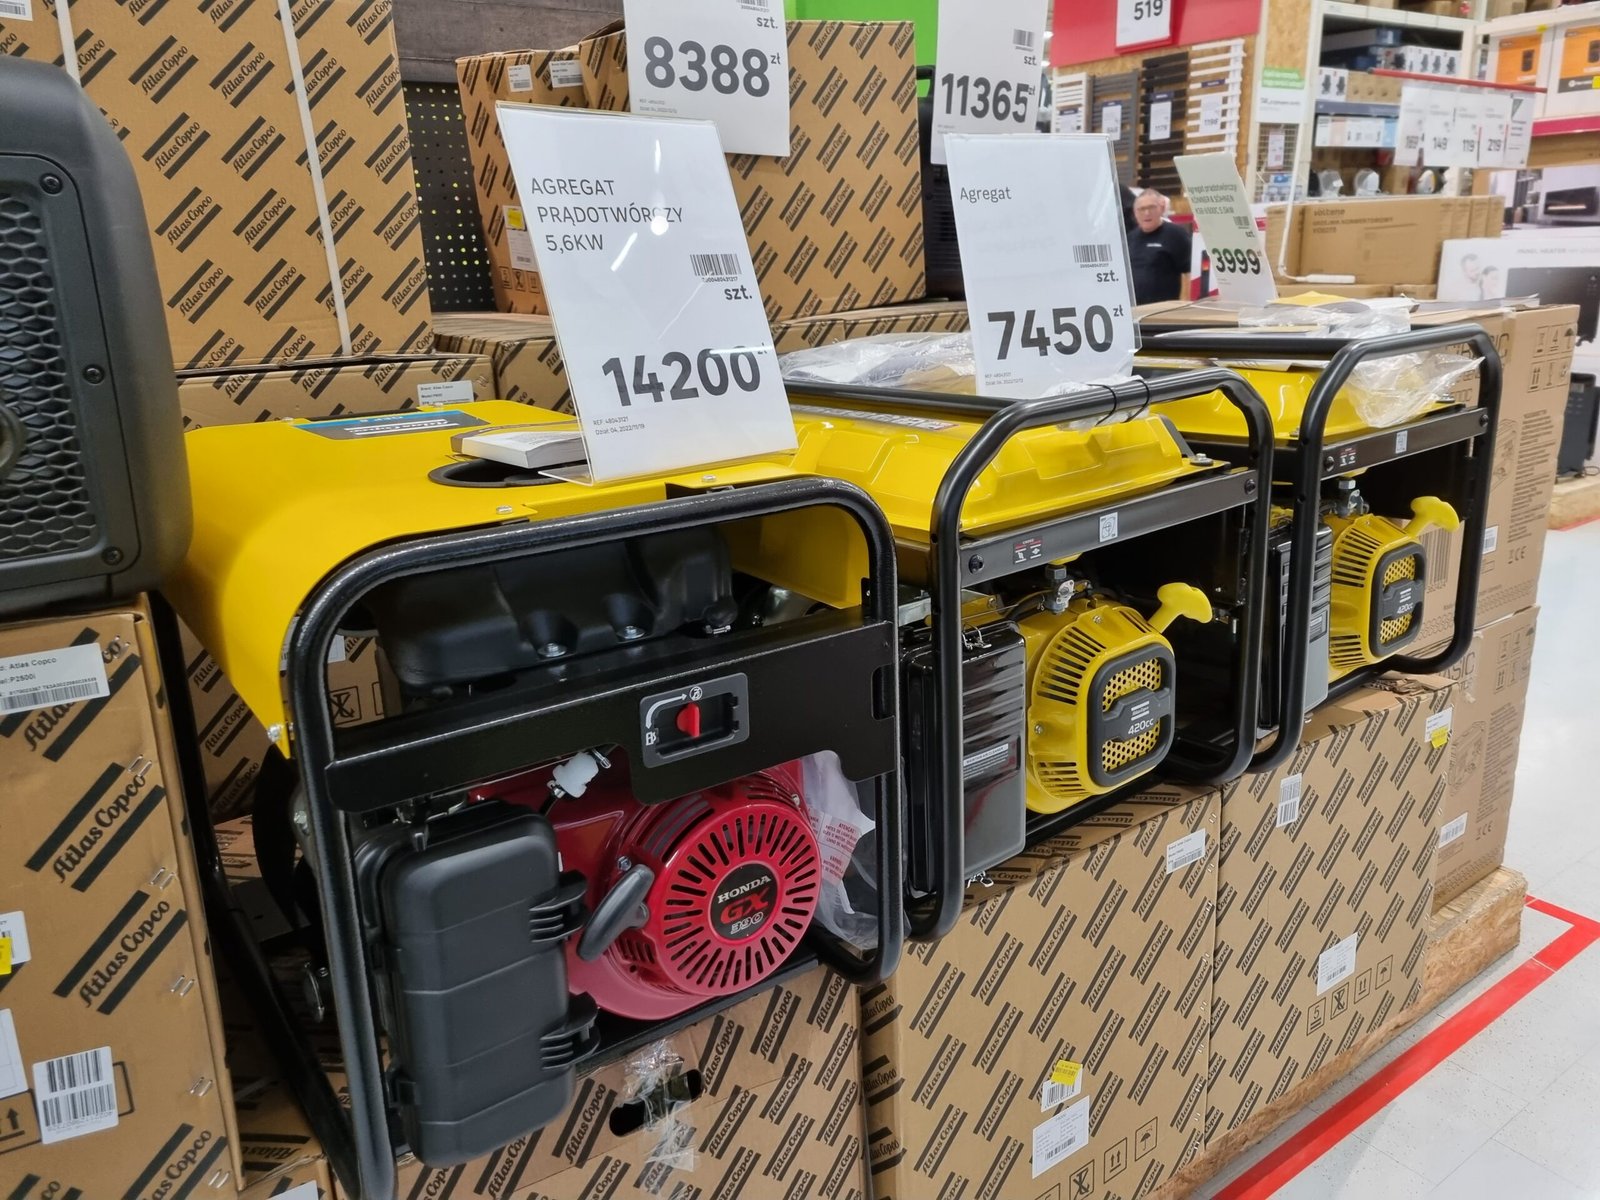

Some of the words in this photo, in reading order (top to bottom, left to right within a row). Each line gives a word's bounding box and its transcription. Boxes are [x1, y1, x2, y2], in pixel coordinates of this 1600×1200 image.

[757, 17, 778, 29] szt.
[1134, 0, 1163, 20] 519
[142, 67, 167, 96] Atlas
[162, 45, 188, 71] Copco
[222, 73, 246, 100] Atlas
[240, 51, 265, 76] Copco
[644, 36, 769, 97] 8388
[770, 52, 781, 65] zł
[941, 73, 1028, 123] 11365
[155, 144, 180, 172] Atlas
[175, 121, 200, 147] Copco
[233, 146, 257, 174] Atlas
[252, 125, 276, 150] Copco
[531, 178, 614, 196] AGREGAT
[960, 187, 1012, 204] Agregat
[168, 218, 192, 246] Atlas
[187, 195, 212, 221] Copco
[245, 218, 268, 245] Atlas
[263, 196, 286, 221] Copco
[546, 234, 603, 254] 5,6KW
[1096, 269, 1119, 283] szt.
[1212, 248, 1261, 275] 3999
[180, 290, 204, 317] Atlas
[199, 267, 223, 293] Copco
[255, 288, 278, 314] Atlas
[273, 266, 296, 291] Copco
[724, 285, 752, 300] szt.
[987, 305, 1114, 360] 7450
[1113, 305, 1124, 317] zł
[602, 345, 761, 407] 14200
[1397, 602, 1414, 614] 420cc
[10, 661, 30, 669] Atlas
[31, 657, 57, 667] Copco
[204, 727, 228, 757] Atlas
[1128, 718, 1154, 735] 420cc
[53, 826, 105, 884] Atlas
[94, 774, 145, 827] Copco
[1321, 850, 1334, 876] Atlas
[1333, 827, 1347, 851] Copco
[1356, 832, 1369, 857] Atlas
[1367, 810, 1381, 833] Copco
[717, 875, 772, 904] HONDA
[720, 887, 769, 924] GX
[1089, 912, 1107, 944] Atlas
[1104, 883, 1122, 913] Copco
[1245, 889, 1260, 917] Atlas
[1258, 865, 1273, 890] Copco
[80, 951, 130, 1008] Atlas
[120, 900, 169, 952] Copco
[1036, 939, 1055, 972] Atlas
[1052, 909, 1071, 939] Copco
[1137, 951, 1153, 982] Atlas
[1151, 924, 1168, 952] Copco
[1241, 946, 1256, 973] Atlas
[1254, 921, 1269, 946] Copco
[980, 968, 999, 1002] Atlas
[997, 937, 1017, 968] Copco
[1088, 977, 1105, 1009] Atlas
[1103, 949, 1121, 978] Copco
[760, 1023, 779, 1059] Atlas
[773, 990, 792, 1023] Copco
[919, 999, 940, 1035] Atlas
[937, 966, 958, 1000] Copco
[1036, 1006, 1054, 1039] Atlas
[1052, 976, 1070, 1006] Copco
[1135, 1013, 1151, 1043] Atlas
[1149, 985, 1166, 1013] Copco
[702, 1054, 721, 1092] Atlas
[715, 1019, 735, 1055] Copco
[981, 1037, 1000, 1071] Atlas
[997, 1006, 1017, 1037] Copco
[1235, 1054, 1249, 1081] Atlas
[1247, 1030, 1261, 1055] Copco
[769, 1089, 789, 1122] Atlas
[786, 1058, 806, 1089] Copco
[921, 1070, 941, 1106] Atlas
[938, 1038, 959, 1071] Copco
[565, 1121, 589, 1163] Atlas
[582, 1083, 606, 1122] Copco
[709, 1122, 731, 1156] Atlas
[727, 1090, 749, 1122] Copco
[824, 1111, 841, 1144] Atlas
[839, 1082, 856, 1112] Copco
[982, 1104, 1000, 1138] Atlas
[998, 1073, 1017, 1105] Copco
[164, 1130, 212, 1180] Copco
[772, 1145, 792, 1179] Atlas
[789, 1115, 808, 1146] Copco
[923, 1140, 943, 1175] Atlas
[940, 1107, 960, 1140] Copco
